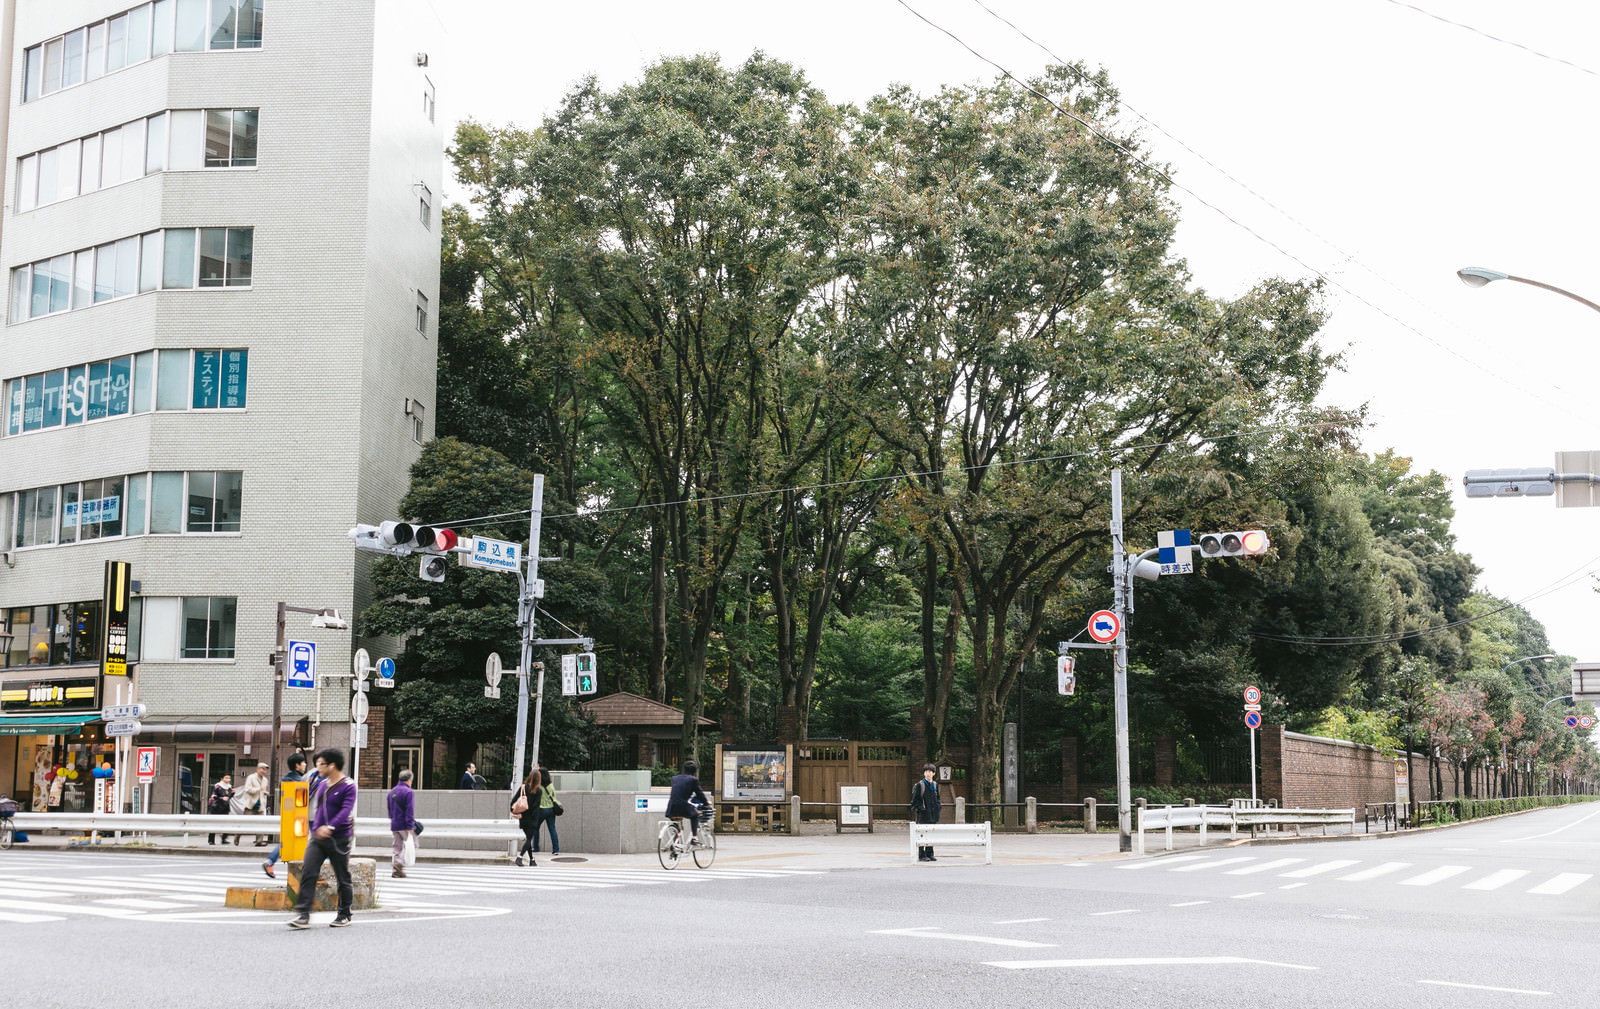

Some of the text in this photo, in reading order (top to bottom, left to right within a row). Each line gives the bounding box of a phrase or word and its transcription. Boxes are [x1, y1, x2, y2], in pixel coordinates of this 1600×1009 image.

[201, 351, 213, 407] テスティー
[44, 373, 129, 417] TESTEA
[477, 541, 516, 560] 駒込橋
[474, 554, 517, 567] Komagomebashi
[1248, 691, 1257, 700] 30
